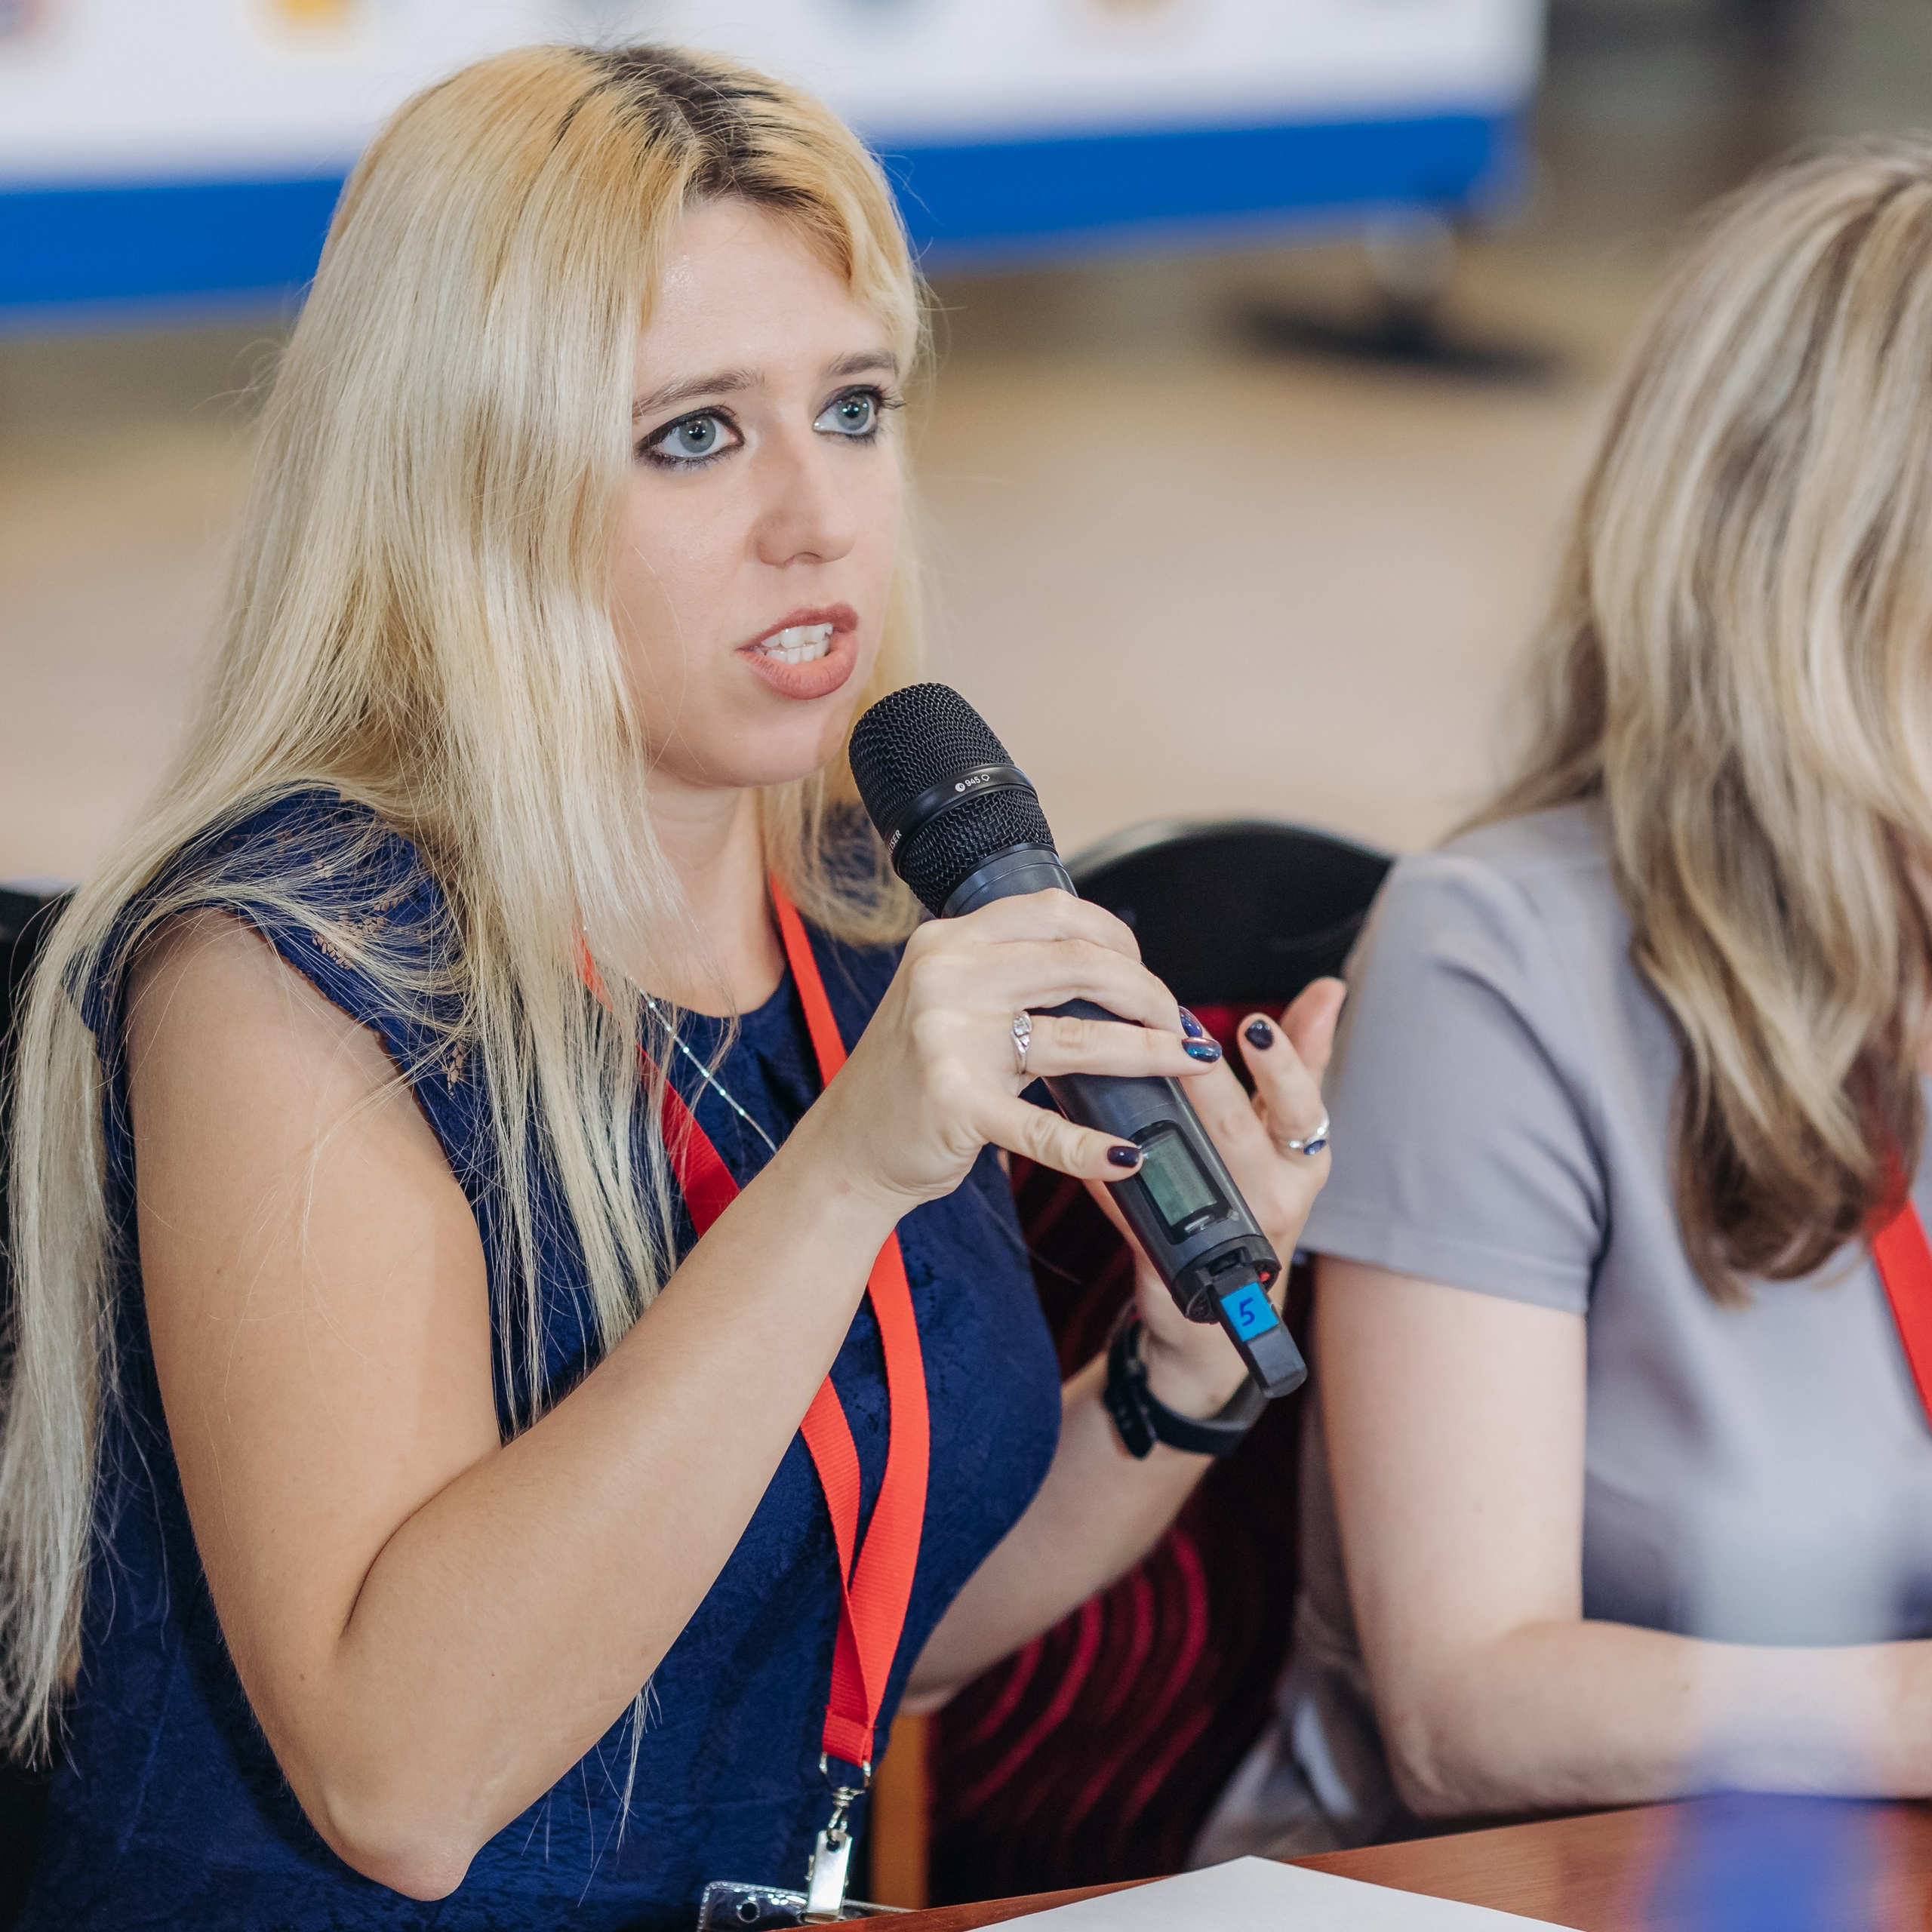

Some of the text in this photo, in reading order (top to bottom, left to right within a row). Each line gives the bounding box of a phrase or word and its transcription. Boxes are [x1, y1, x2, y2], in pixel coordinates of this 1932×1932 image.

[964, 776, 981, 787] 945
[888, 829, 902, 854] EISER
[1238, 1297, 1256, 1327] 5
